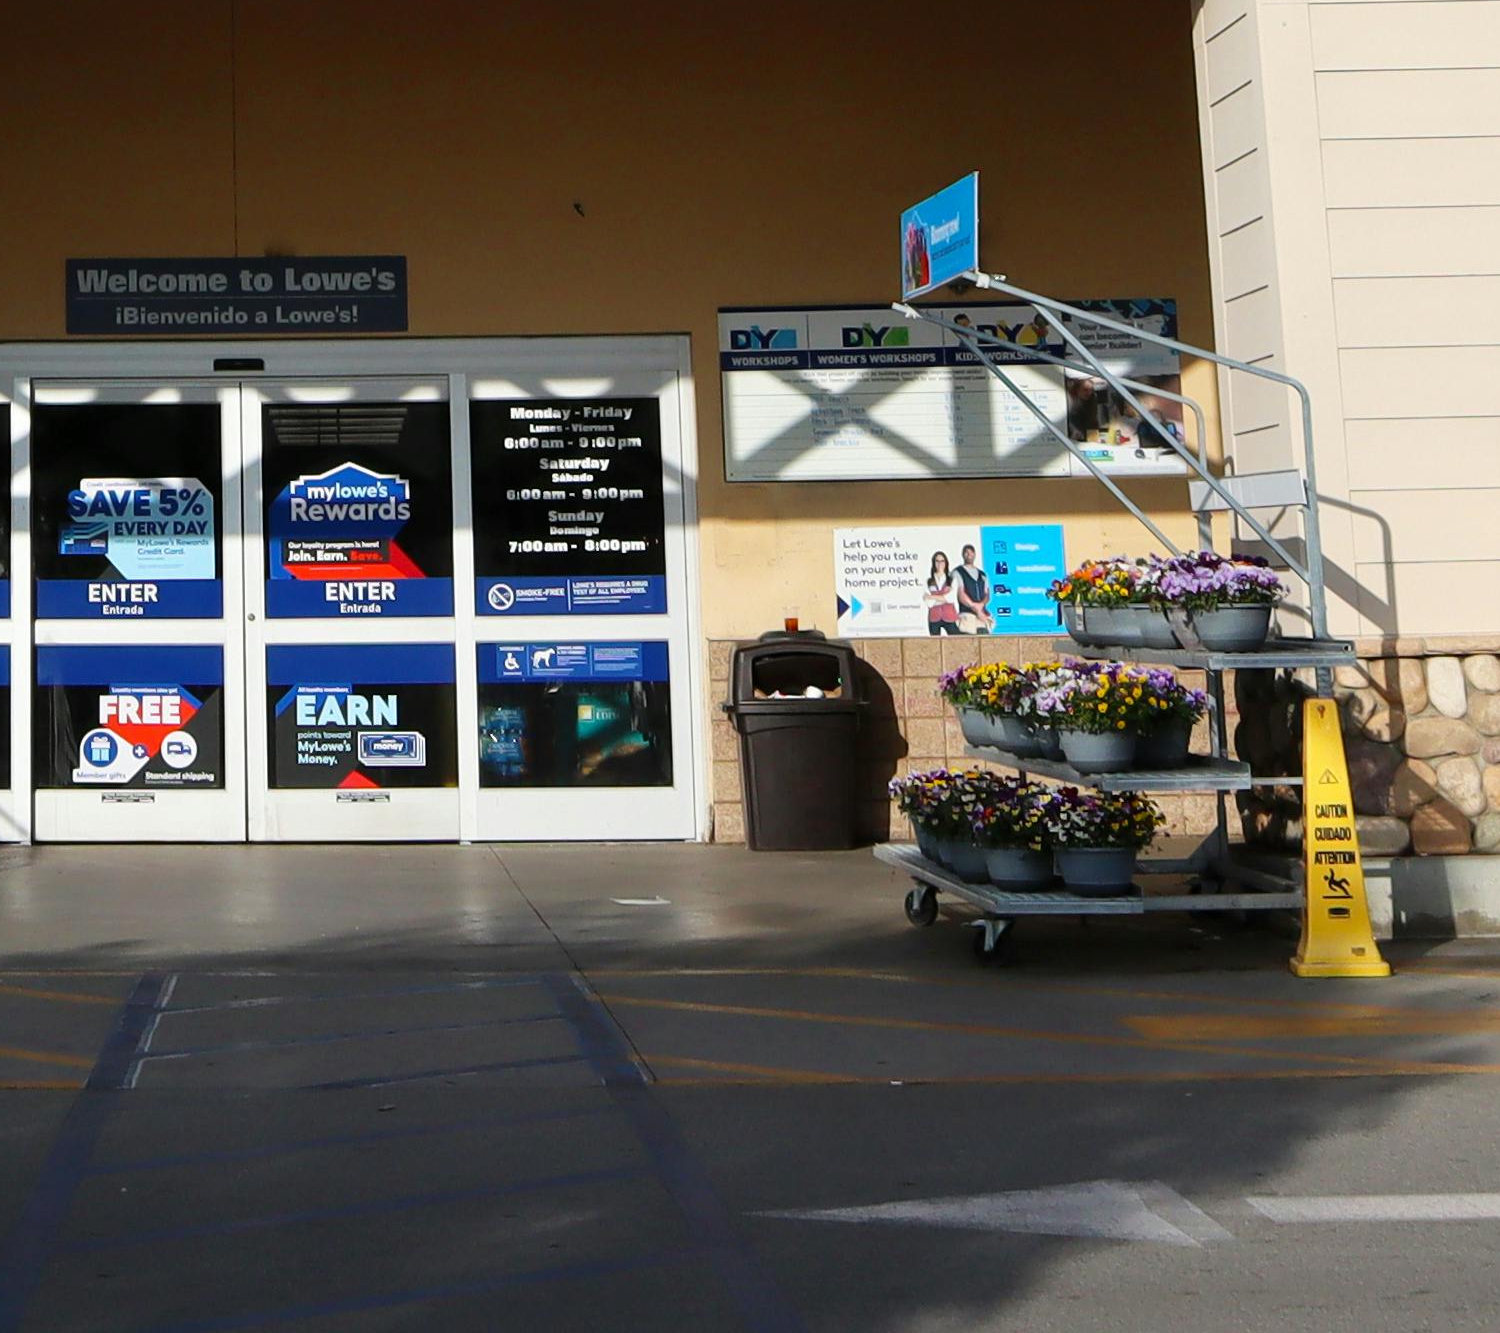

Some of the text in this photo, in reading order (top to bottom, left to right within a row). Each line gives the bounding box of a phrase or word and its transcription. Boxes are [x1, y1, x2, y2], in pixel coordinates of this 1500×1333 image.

[76, 267, 396, 294] Welcome to Lowe's
[116, 305, 358, 326] ¡Bienvenido a Lowe's!
[731, 355, 799, 366] WORKSHOPS
[817, 353, 937, 365] WOMEN'S WORKSHOPS
[510, 406, 633, 420] Monday Friday
[571, 423, 615, 432] Viernes
[539, 457, 610, 471] Saturday
[551, 472, 594, 483] Sábado
[307, 481, 389, 502] mylowe's
[67, 489, 152, 517] SAVE
[290, 496, 411, 522] Rewards
[548, 510, 604, 524] Sunday
[114, 521, 209, 536] EVERY DAY
[549, 527, 600, 537] Domingo
[176, 538, 209, 546] Rewards
[842, 537, 901, 549] Let Lowe's
[137, 547, 162, 555] Credit
[288, 551, 315, 562] Join.
[316, 551, 348, 562] Earn.
[844, 551, 918, 563] help you take
[844, 565, 914, 576] on your next
[844, 577, 923, 590] home project.
[88, 583, 158, 603] ENTER
[325, 582, 395, 601] ENTER
[102, 604, 144, 616] Entrada
[340, 603, 382, 614] Entrada
[99, 695, 181, 725] FREE
[296, 694, 398, 726] EARN
[298, 731, 352, 740] points toward
[298, 740, 352, 752] MyLowe's
[373, 742, 403, 751] money
[298, 753, 338, 766] Money.
[109, 771, 127, 780] gifts
[182, 771, 215, 782] shipping
[1315, 804, 1347, 819] CAUTION
[1314, 826, 1352, 841] CUIDADO
[1314, 850, 1356, 865] ATTENTION
